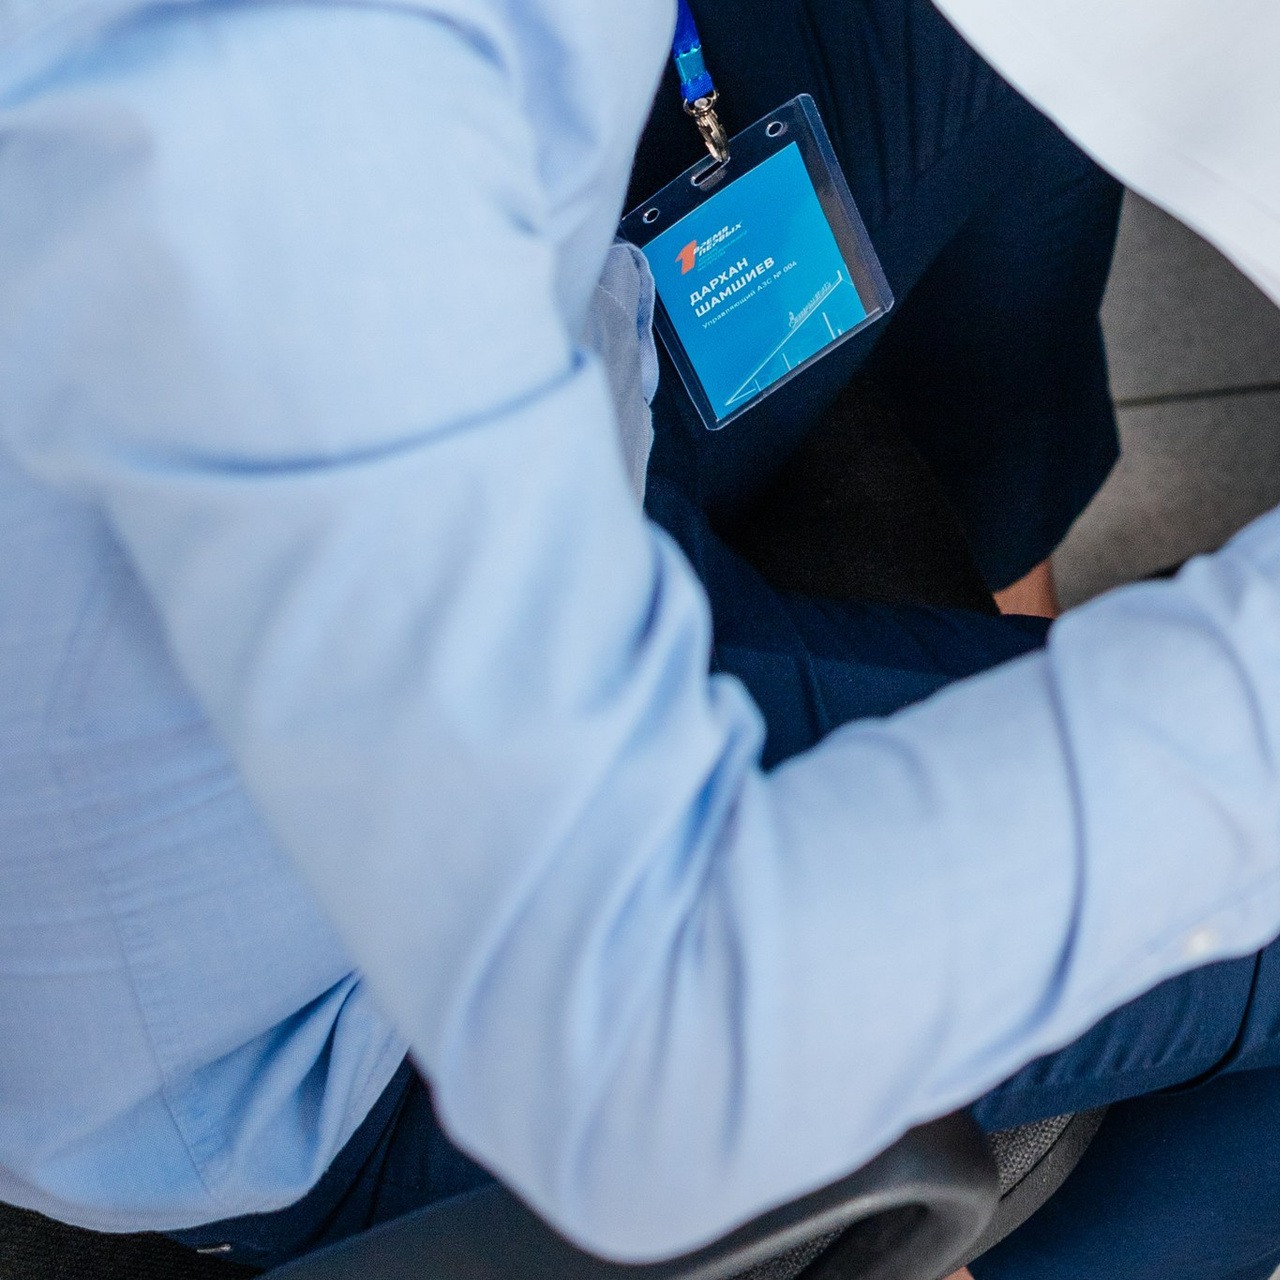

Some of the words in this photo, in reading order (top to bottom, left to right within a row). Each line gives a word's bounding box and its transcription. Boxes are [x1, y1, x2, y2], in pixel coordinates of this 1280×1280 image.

[689, 257, 749, 307] ДАРХАН
[695, 257, 775, 318] ШАМШИЕВ
[702, 290, 756, 329] Управляющий
[757, 277, 773, 293] АЗС
[783, 261, 797, 273] 004
